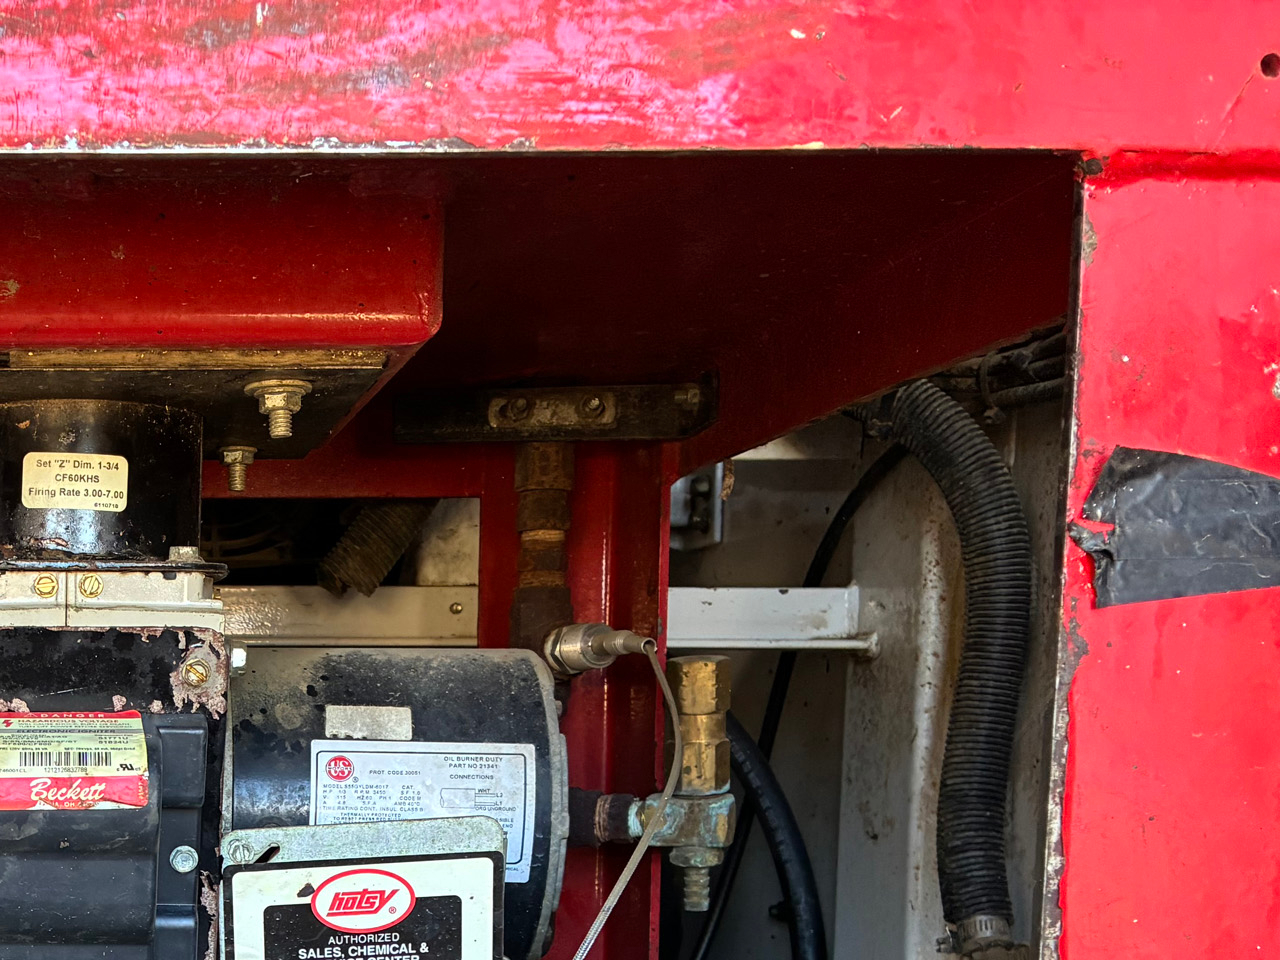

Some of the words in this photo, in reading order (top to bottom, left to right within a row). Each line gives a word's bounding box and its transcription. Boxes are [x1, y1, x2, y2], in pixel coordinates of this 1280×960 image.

[36, 459, 51, 468] Set
[73, 460, 95, 469] Dim.
[98, 462, 119, 471] 1-3/4
[55, 474, 100, 483] CF60KHS
[28, 487, 56, 498] Firing
[59, 488, 80, 497] Rate
[83, 489, 124, 499] 3.00-7.00
[29, 778, 107, 801] Beckett
[328, 932, 400, 945] AUTHORIZED
[298, 947, 345, 960] SALES,
[348, 943, 417, 957] CHEMICAL
[419, 942, 429, 953] &
